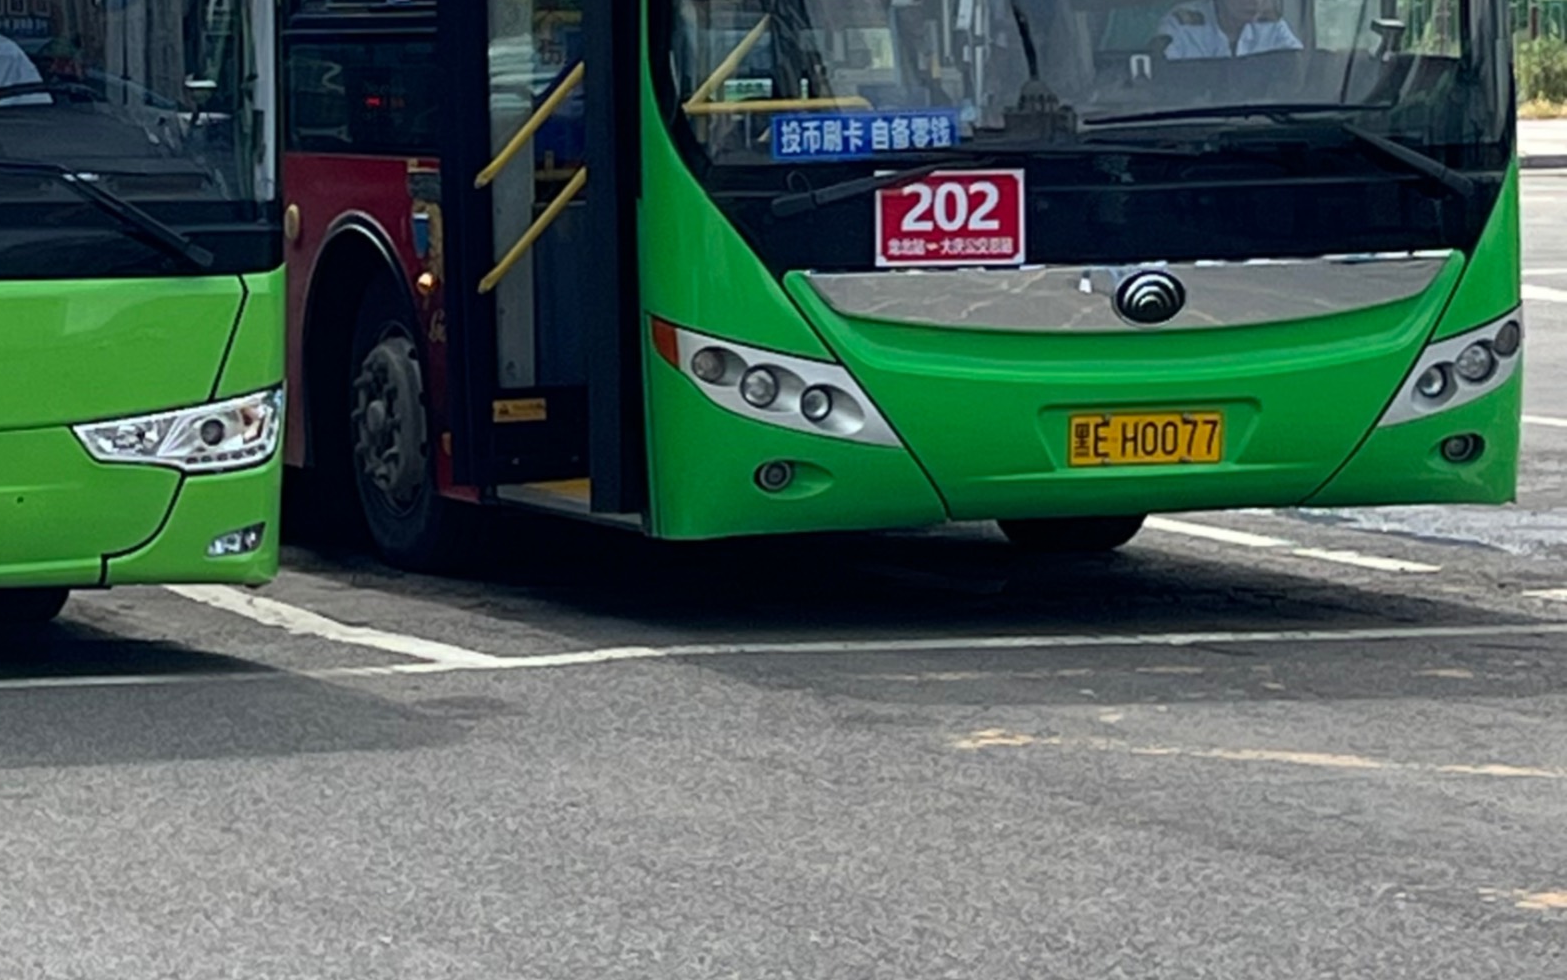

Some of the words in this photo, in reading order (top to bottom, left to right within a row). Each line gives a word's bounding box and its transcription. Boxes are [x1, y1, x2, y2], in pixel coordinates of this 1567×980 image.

[780, 119, 863, 154] 投币刷卡
[871, 116, 951, 150] 自备零钱
[900, 181, 1000, 232] 202
